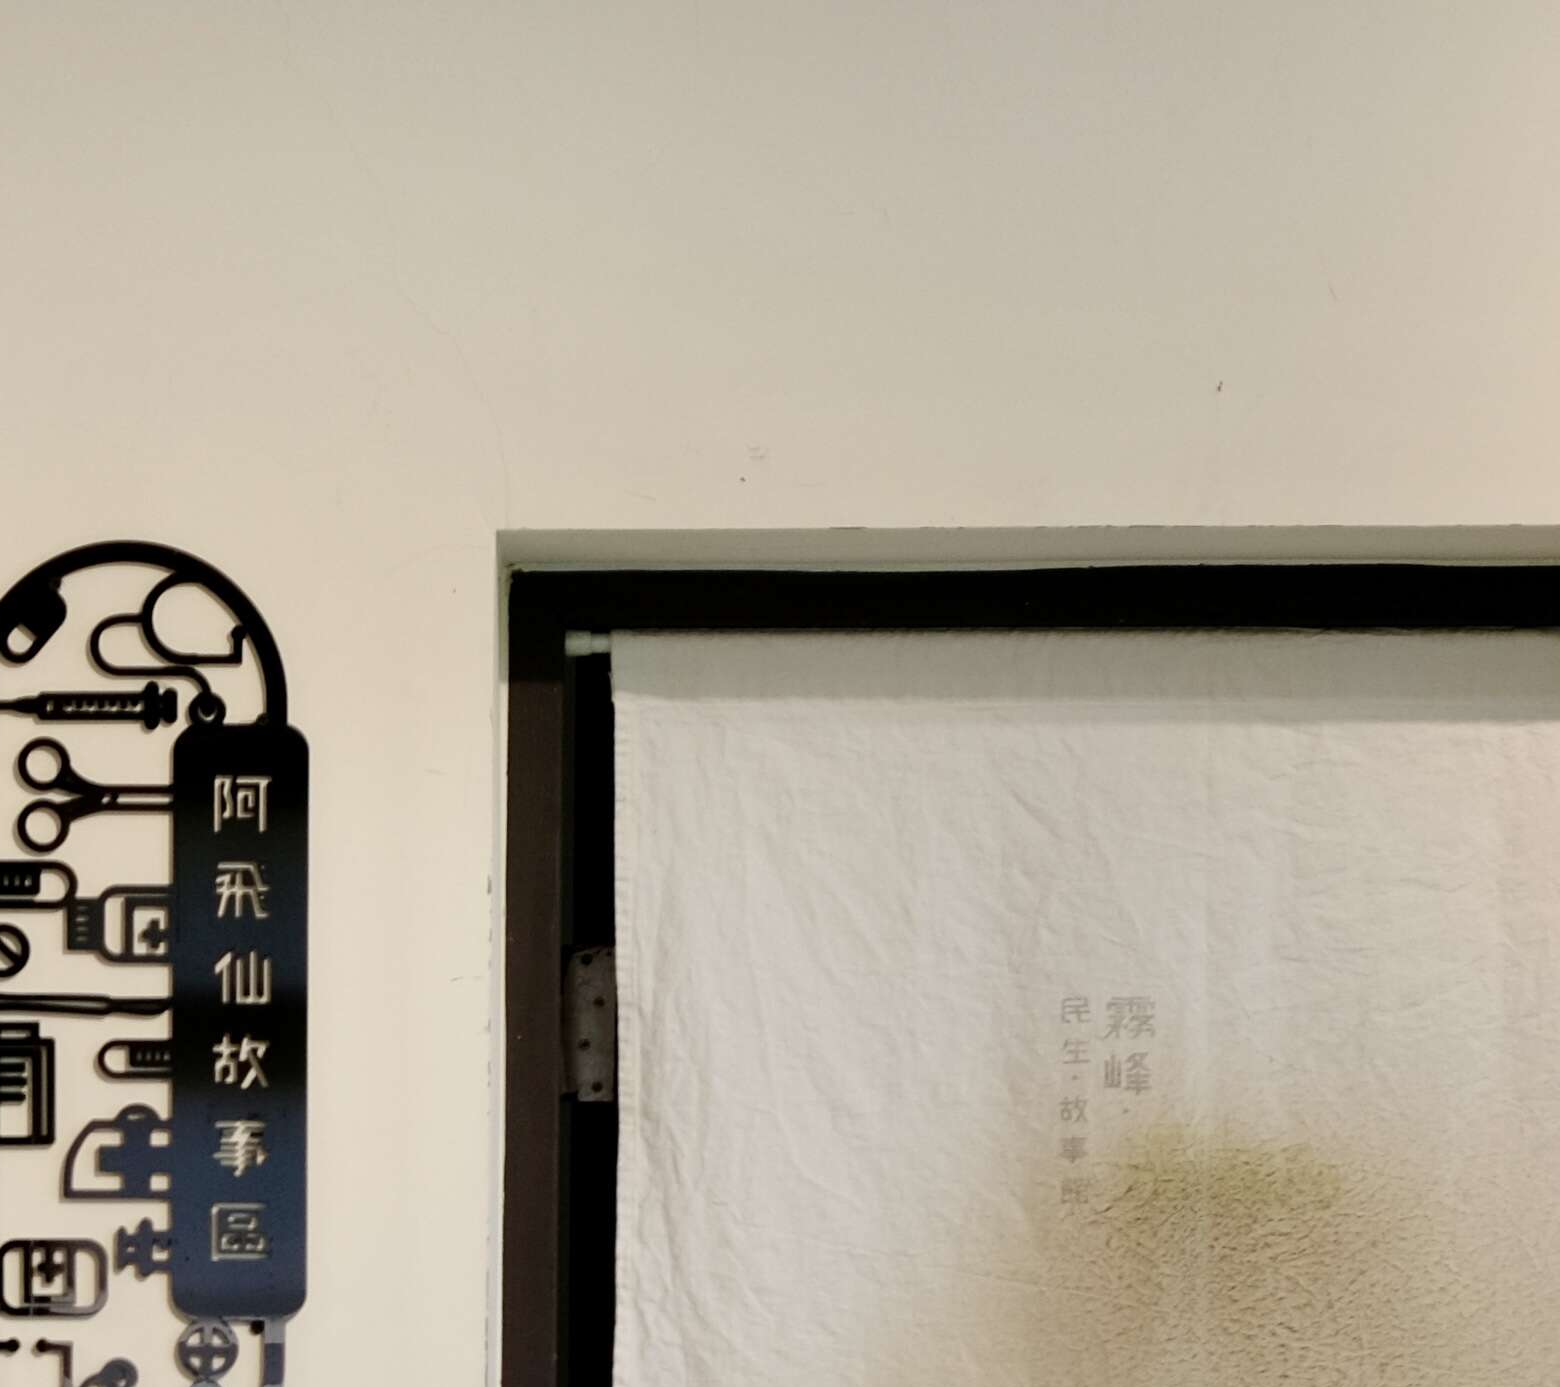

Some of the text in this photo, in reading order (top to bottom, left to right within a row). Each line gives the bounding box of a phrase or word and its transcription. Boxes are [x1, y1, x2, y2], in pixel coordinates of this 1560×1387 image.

[210, 775, 273, 1262] 阿飛仙故事區
